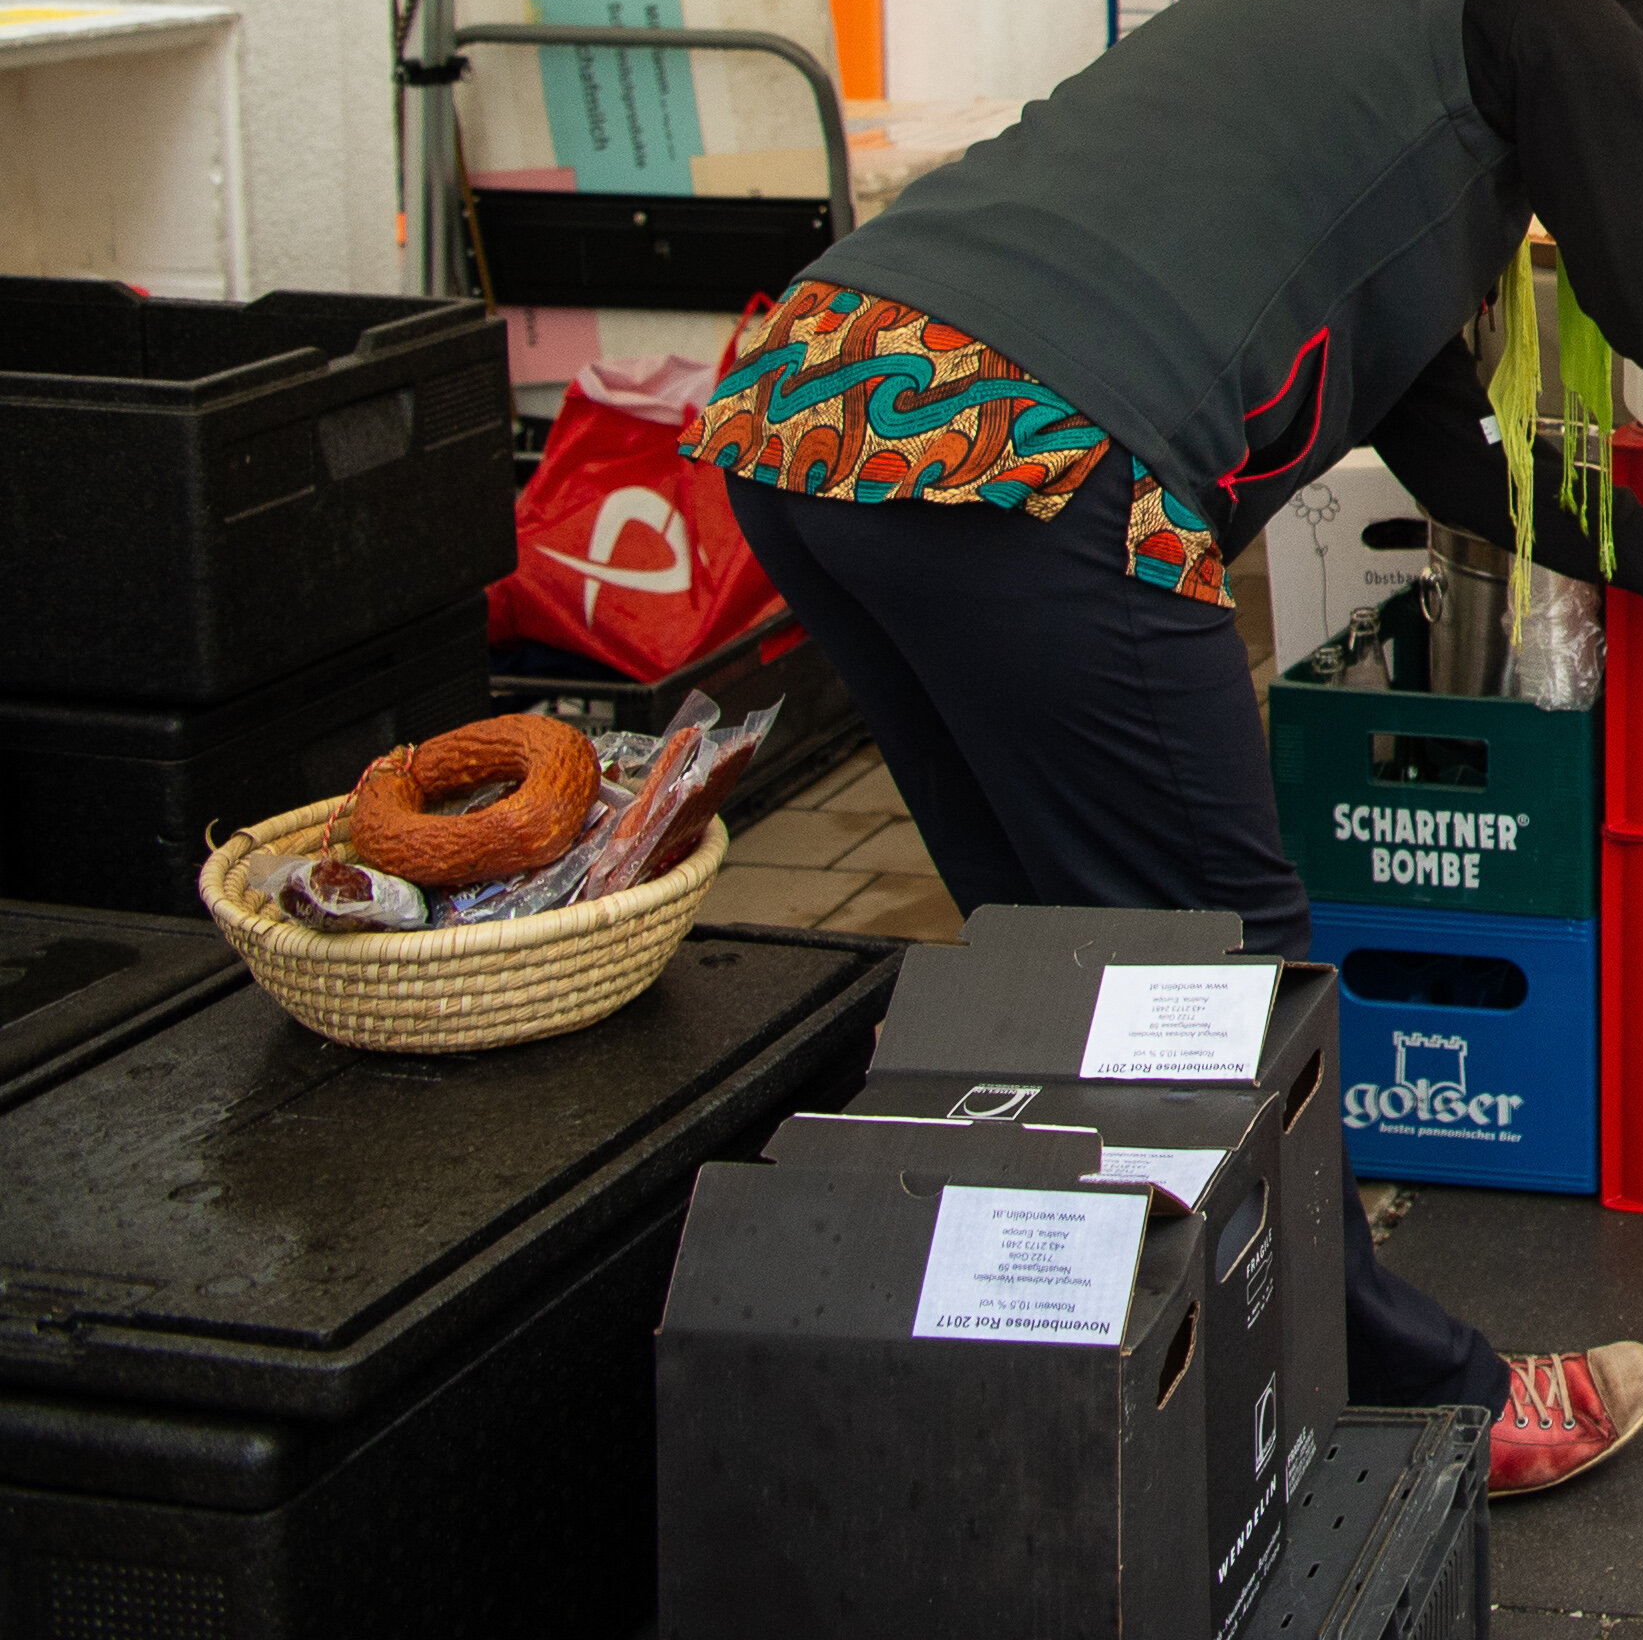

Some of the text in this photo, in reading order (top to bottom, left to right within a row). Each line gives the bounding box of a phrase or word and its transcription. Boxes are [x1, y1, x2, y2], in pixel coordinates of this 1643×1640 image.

[1334, 803, 1518, 851] SCHARTNER
[1372, 847, 1481, 889] BOMBE
[1098, 1063, 1244, 1073] Novemberlese Rot 2017
[992, 1209, 1086, 1223] www.wendelin.at
[1002, 1228, 1033, 1238] Europe
[1025, 1241, 1047, 1251] 2173
[1049, 1241, 1065, 1251] +43
[1009, 1252, 1053, 1263] 7122 Gols
[1246, 1227, 1273, 1278] FRAGILE
[998, 1263, 1009, 1272] 59
[973, 1273, 1091, 1287] Weingut Andreas Wendelin
[979, 1299, 994, 1309] vol
[997, 1300, 1007, 1310] %
[1035, 1301, 1075, 1313] Rotwein
[936, 1315, 1110, 1335] Novemberlese Rot 2017
[1217, 1473, 1277, 1585] WENDELIN
